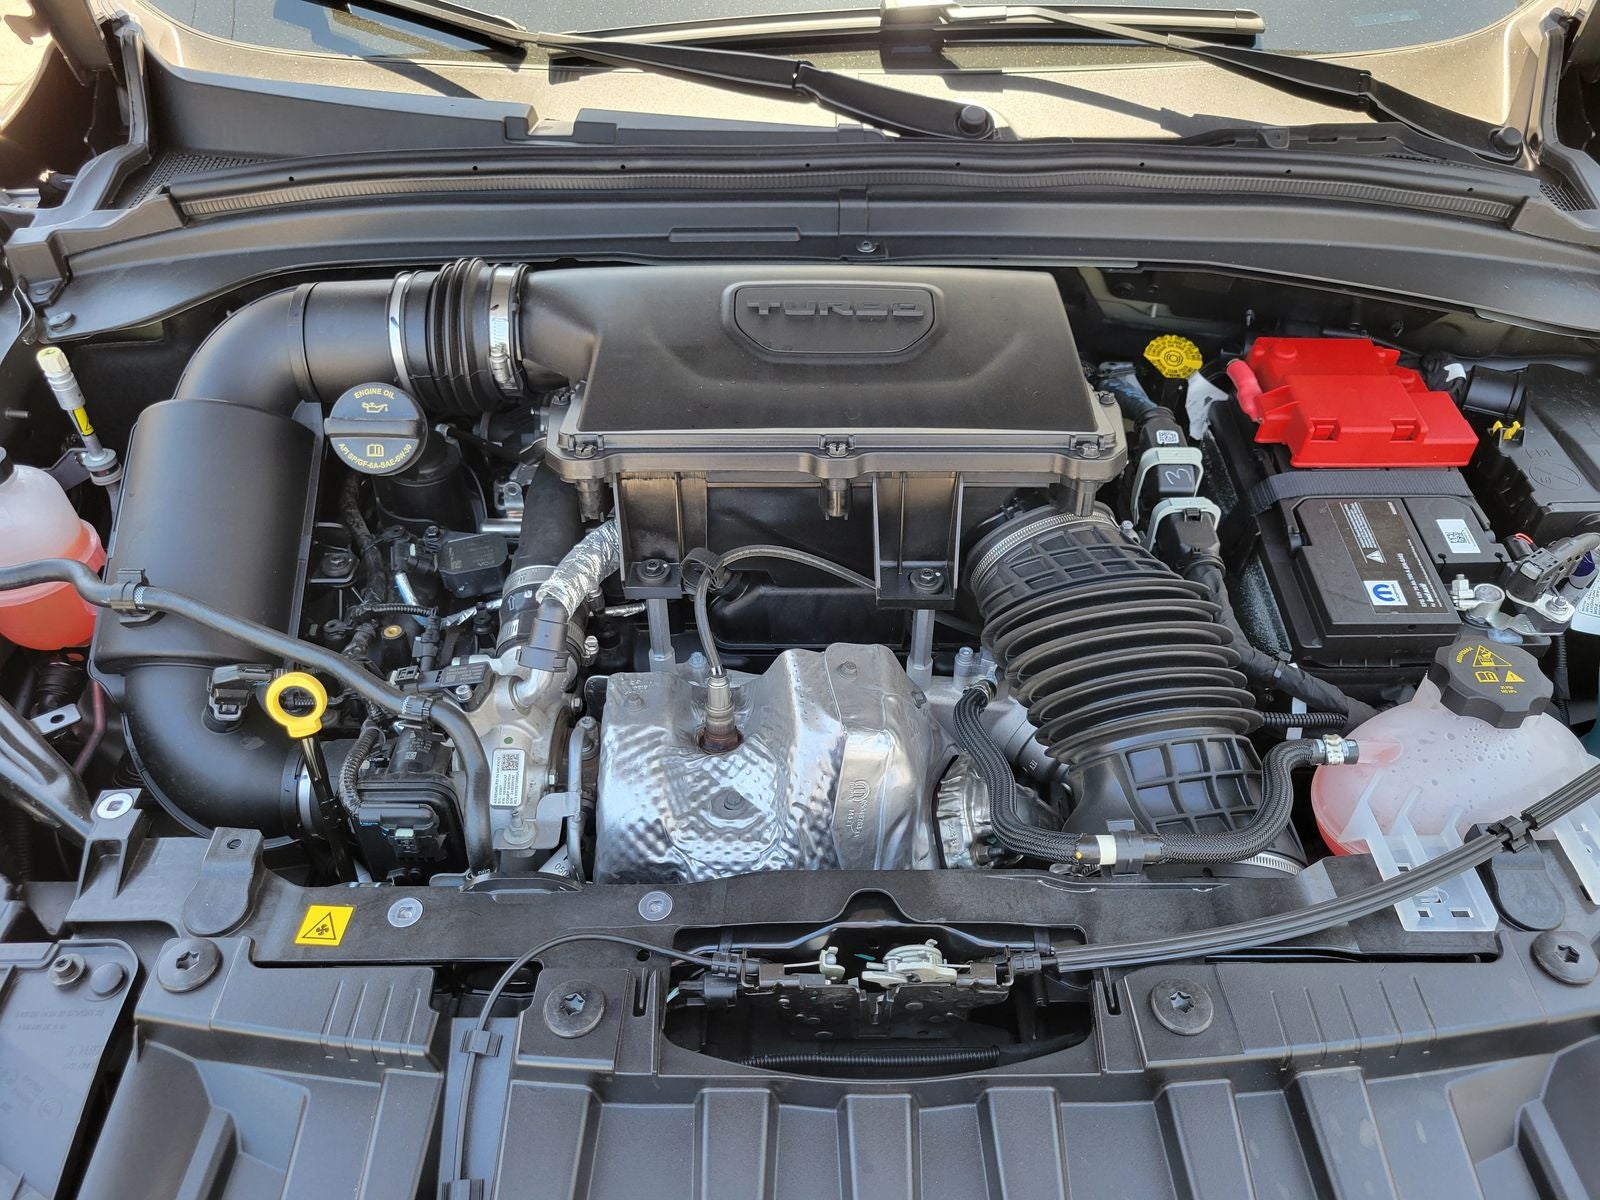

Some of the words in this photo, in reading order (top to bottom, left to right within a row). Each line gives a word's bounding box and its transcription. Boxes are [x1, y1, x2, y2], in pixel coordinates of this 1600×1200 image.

[747, 300, 924, 317] TURBO
[354, 388, 382, 399] ENGINE
[383, 389, 396, 400] OIL
[338, 443, 350, 455] API
